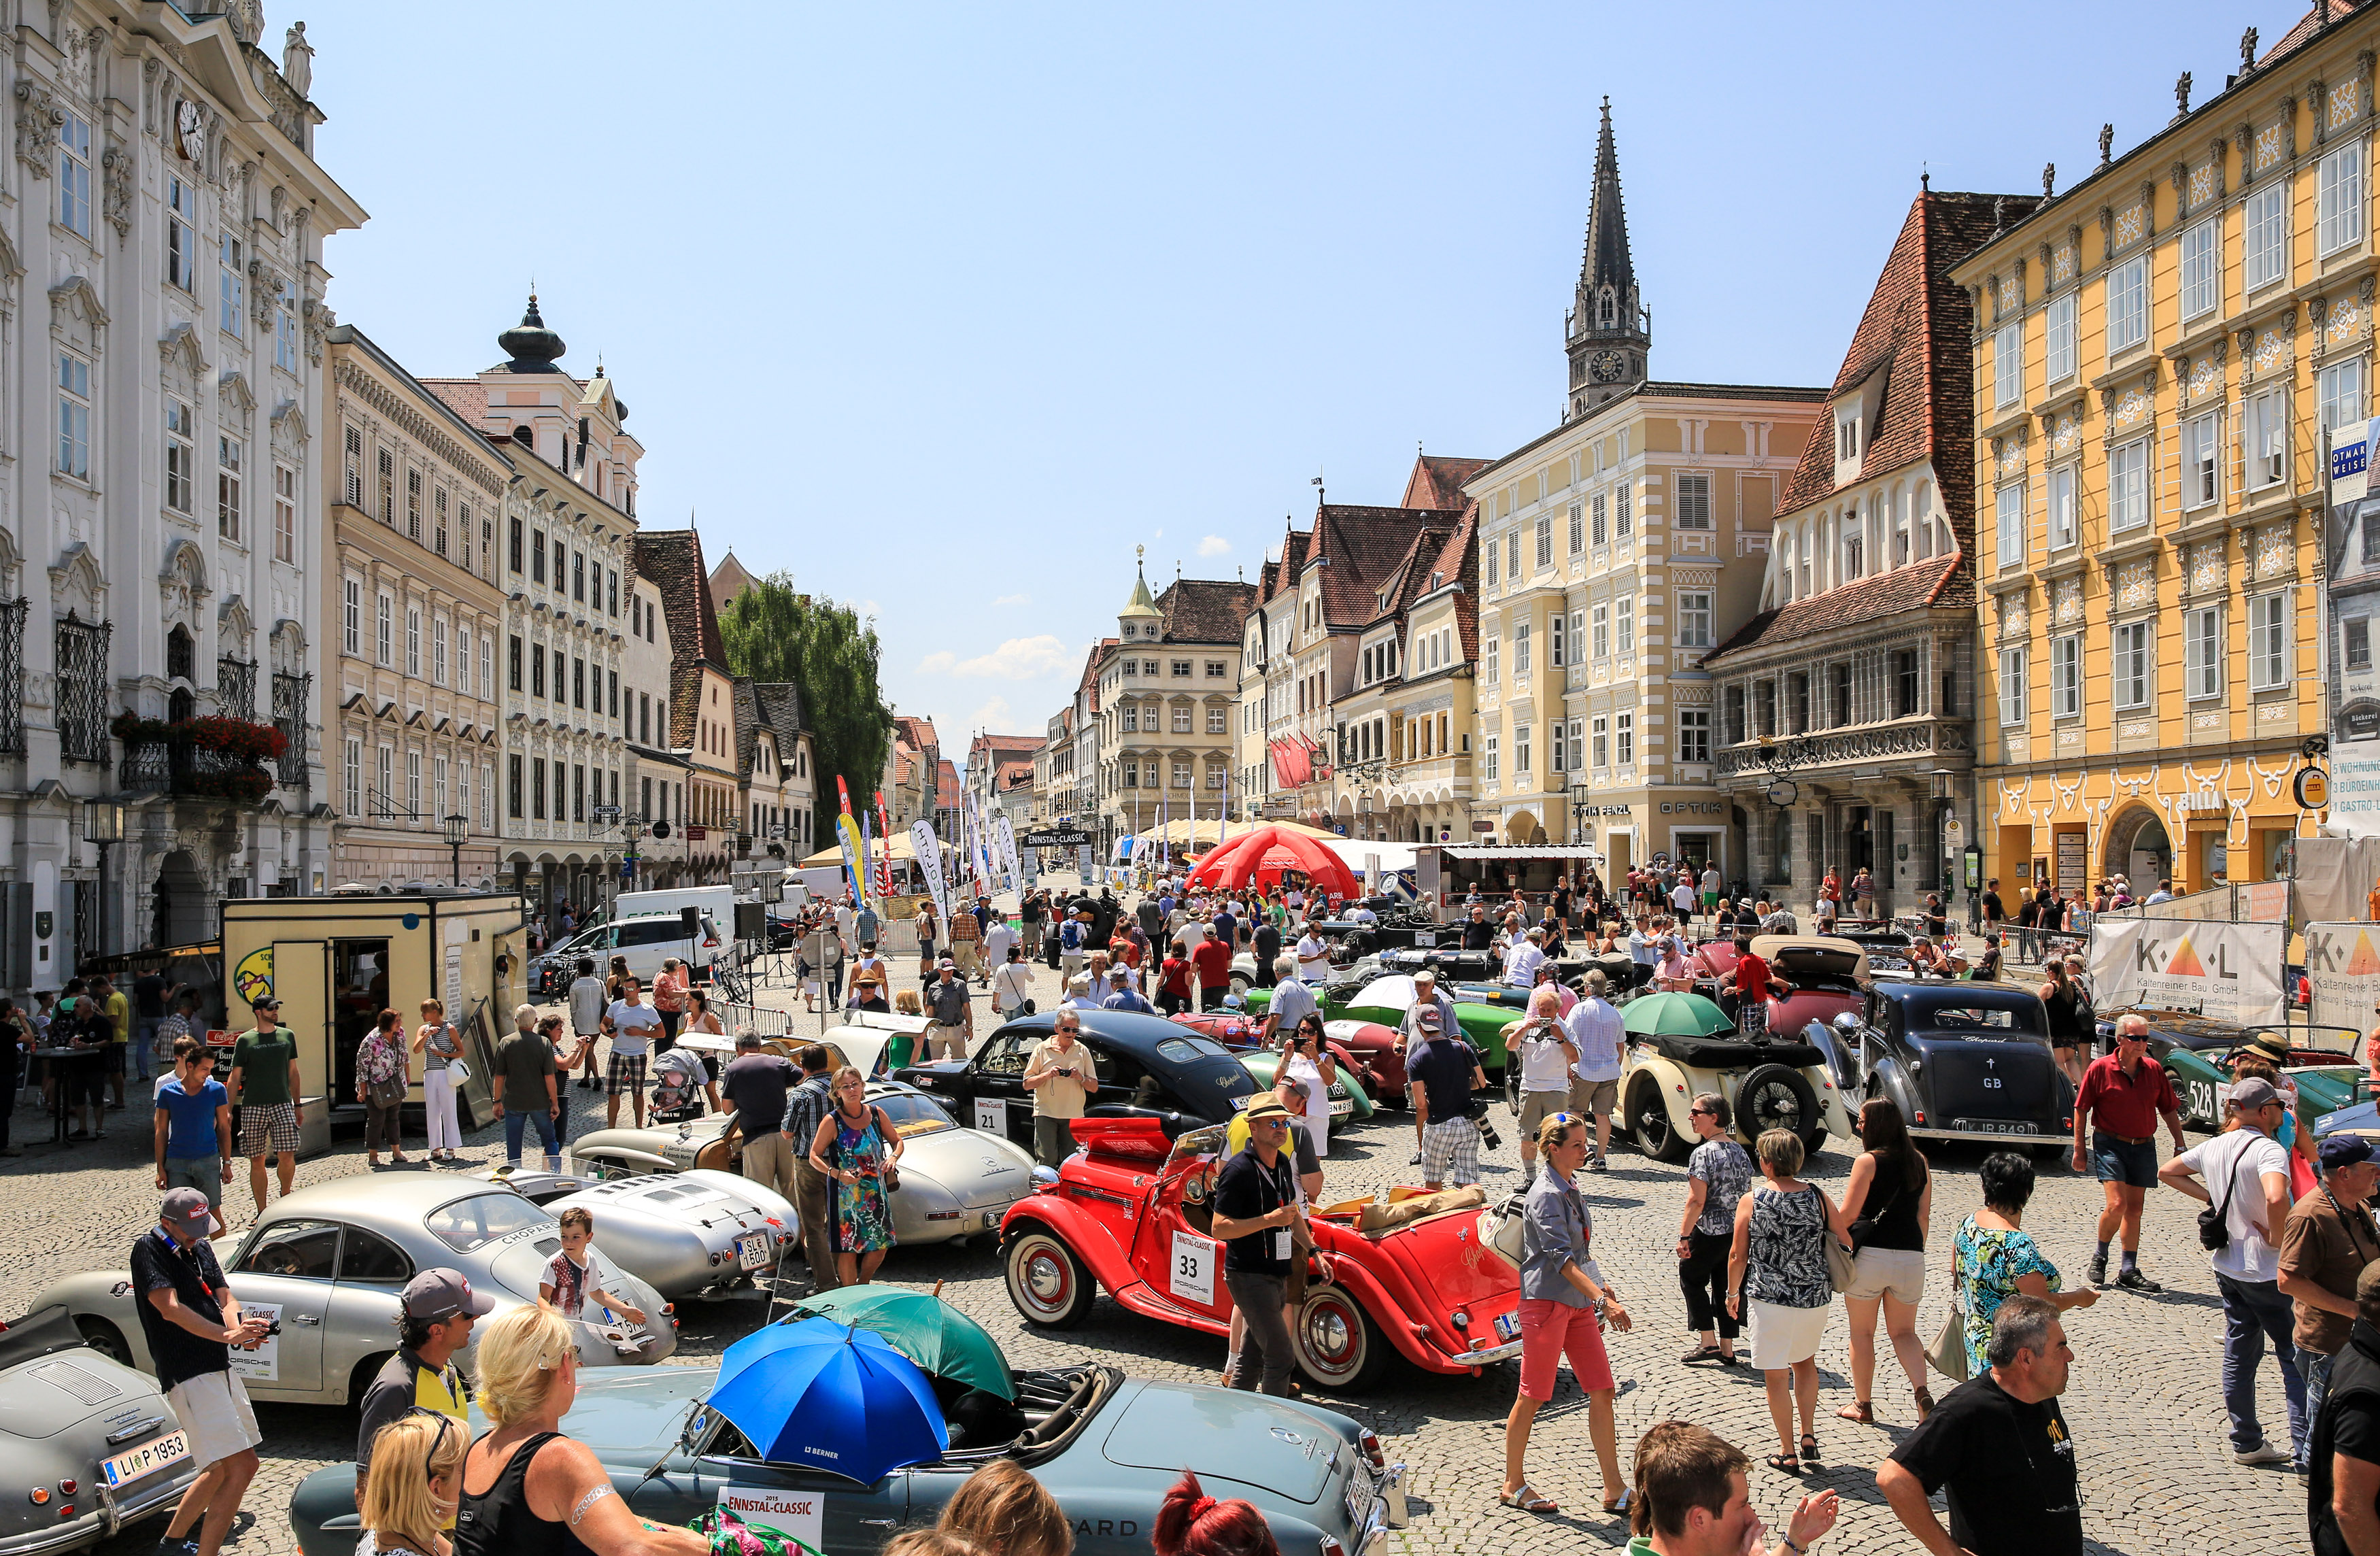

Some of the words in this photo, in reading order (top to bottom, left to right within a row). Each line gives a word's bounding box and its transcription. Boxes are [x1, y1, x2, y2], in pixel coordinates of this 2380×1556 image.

[2332, 444, 2365, 464] OTMAR
[2333, 456, 2365, 475] WEISE
[2351, 713, 2378, 722] Bäckerei
[2333, 764, 2337, 775] 5
[2334, 783, 2338, 794] 3
[1661, 802, 1722, 813] OPTIK
[2180, 791, 2225, 811] BILLA
[2334, 801, 2337, 812] 1
[1601, 805, 1630, 816] FENZL
[1028, 832, 1085, 845] ENNSTAL-CLASSIC
[2137, 977, 2188, 991] Kaltenreiner
[2192, 981, 2207, 992] Bau
[2212, 983, 2238, 996] GmbH
[2162, 993, 2190, 1004] Beratung
[1961, 1035, 2007, 1044] Chopard
[1216, 1069, 1241, 1088] Chopard
[1984, 1078, 2002, 1089] GB
[1331, 1086, 1345, 1096] 100
[977, 1101, 1003, 1109] ENNSTAL-CLASSIC
[2189, 1080, 2213, 1119] 528
[981, 1115, 995, 1129] 21
[1998, 1124, 2025, 1134] 849
[502, 1221, 561, 1244] CHOPARD
[746, 1239, 758, 1252] SL
[1177, 1234, 1211, 1252] ENNSTAL-CLASSIC
[1180, 1255, 1198, 1279] 33
[1174, 1279, 1208, 1293] PORSCHE
[120, 1459, 135, 1476] LI
[142, 1450, 151, 1467] P
[153, 1436, 184, 1461] 1953
[813, 1448, 838, 1459] BERNER
[729, 1495, 812, 1515] ENNSTAL-CLASSIC
